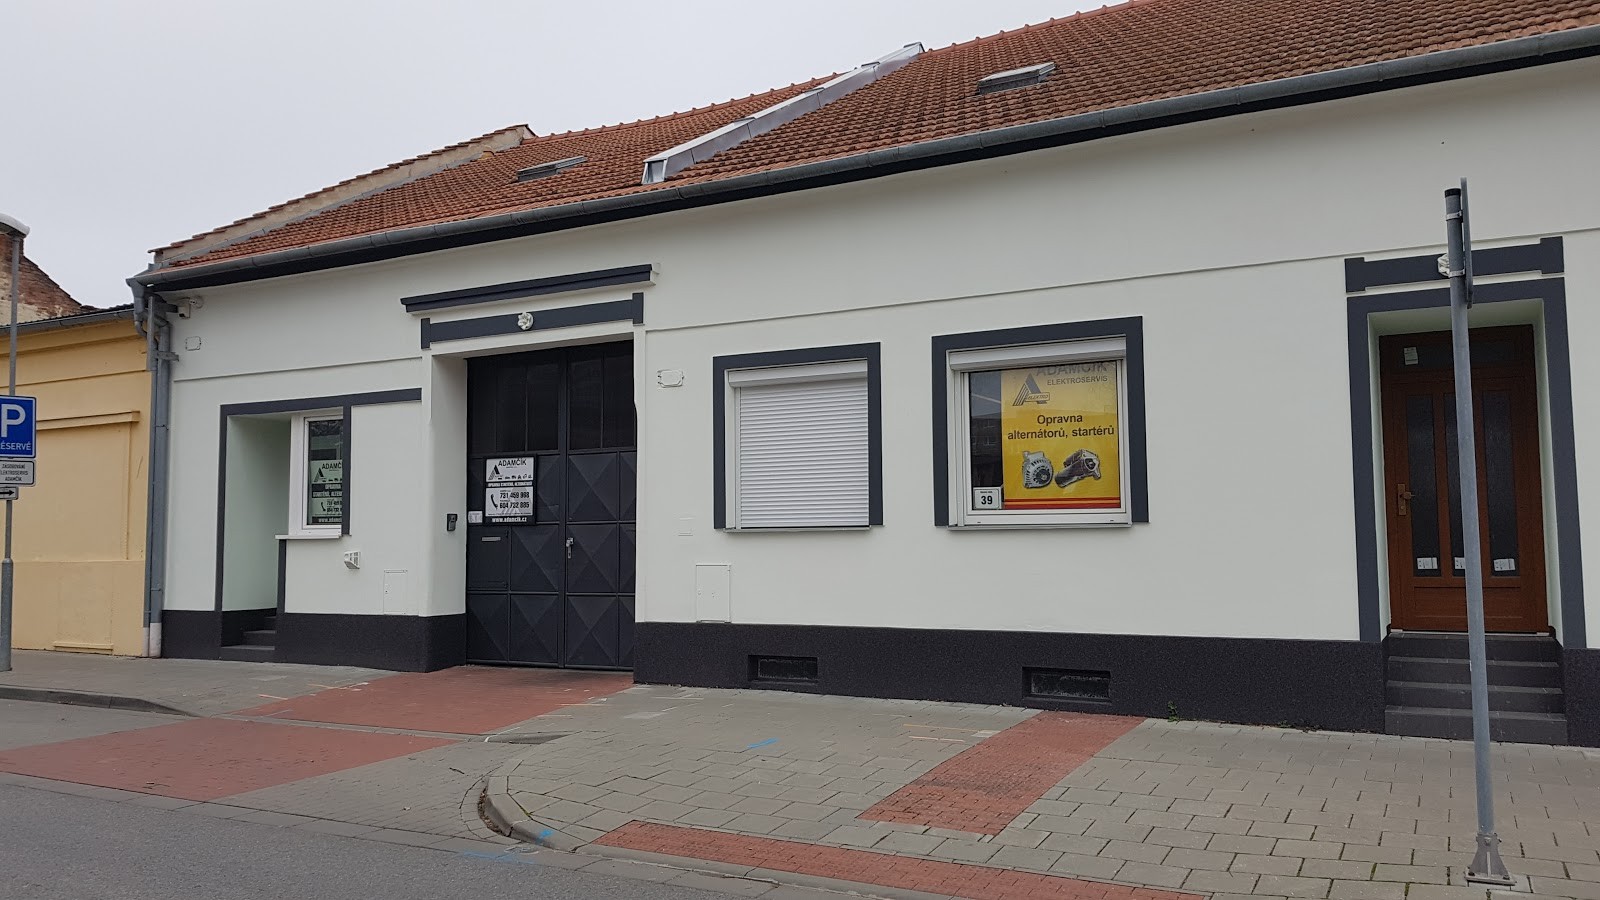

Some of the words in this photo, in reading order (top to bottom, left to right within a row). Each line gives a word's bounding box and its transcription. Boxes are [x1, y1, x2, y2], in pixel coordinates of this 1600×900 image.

[1047, 376, 1108, 386] ELEKTROSERVIS
[1, 404, 26, 437] P
[1037, 414, 1083, 426] Opravna
[1007, 427, 1068, 440] alternátorů,
[1072, 424, 1115, 437] startérů
[0, 441, 31, 450] ÉSERVÉ
[321, 462, 342, 470] ADAMČ
[498, 458, 527, 467] ADAMČÍK
[981, 495, 993, 505] 39
